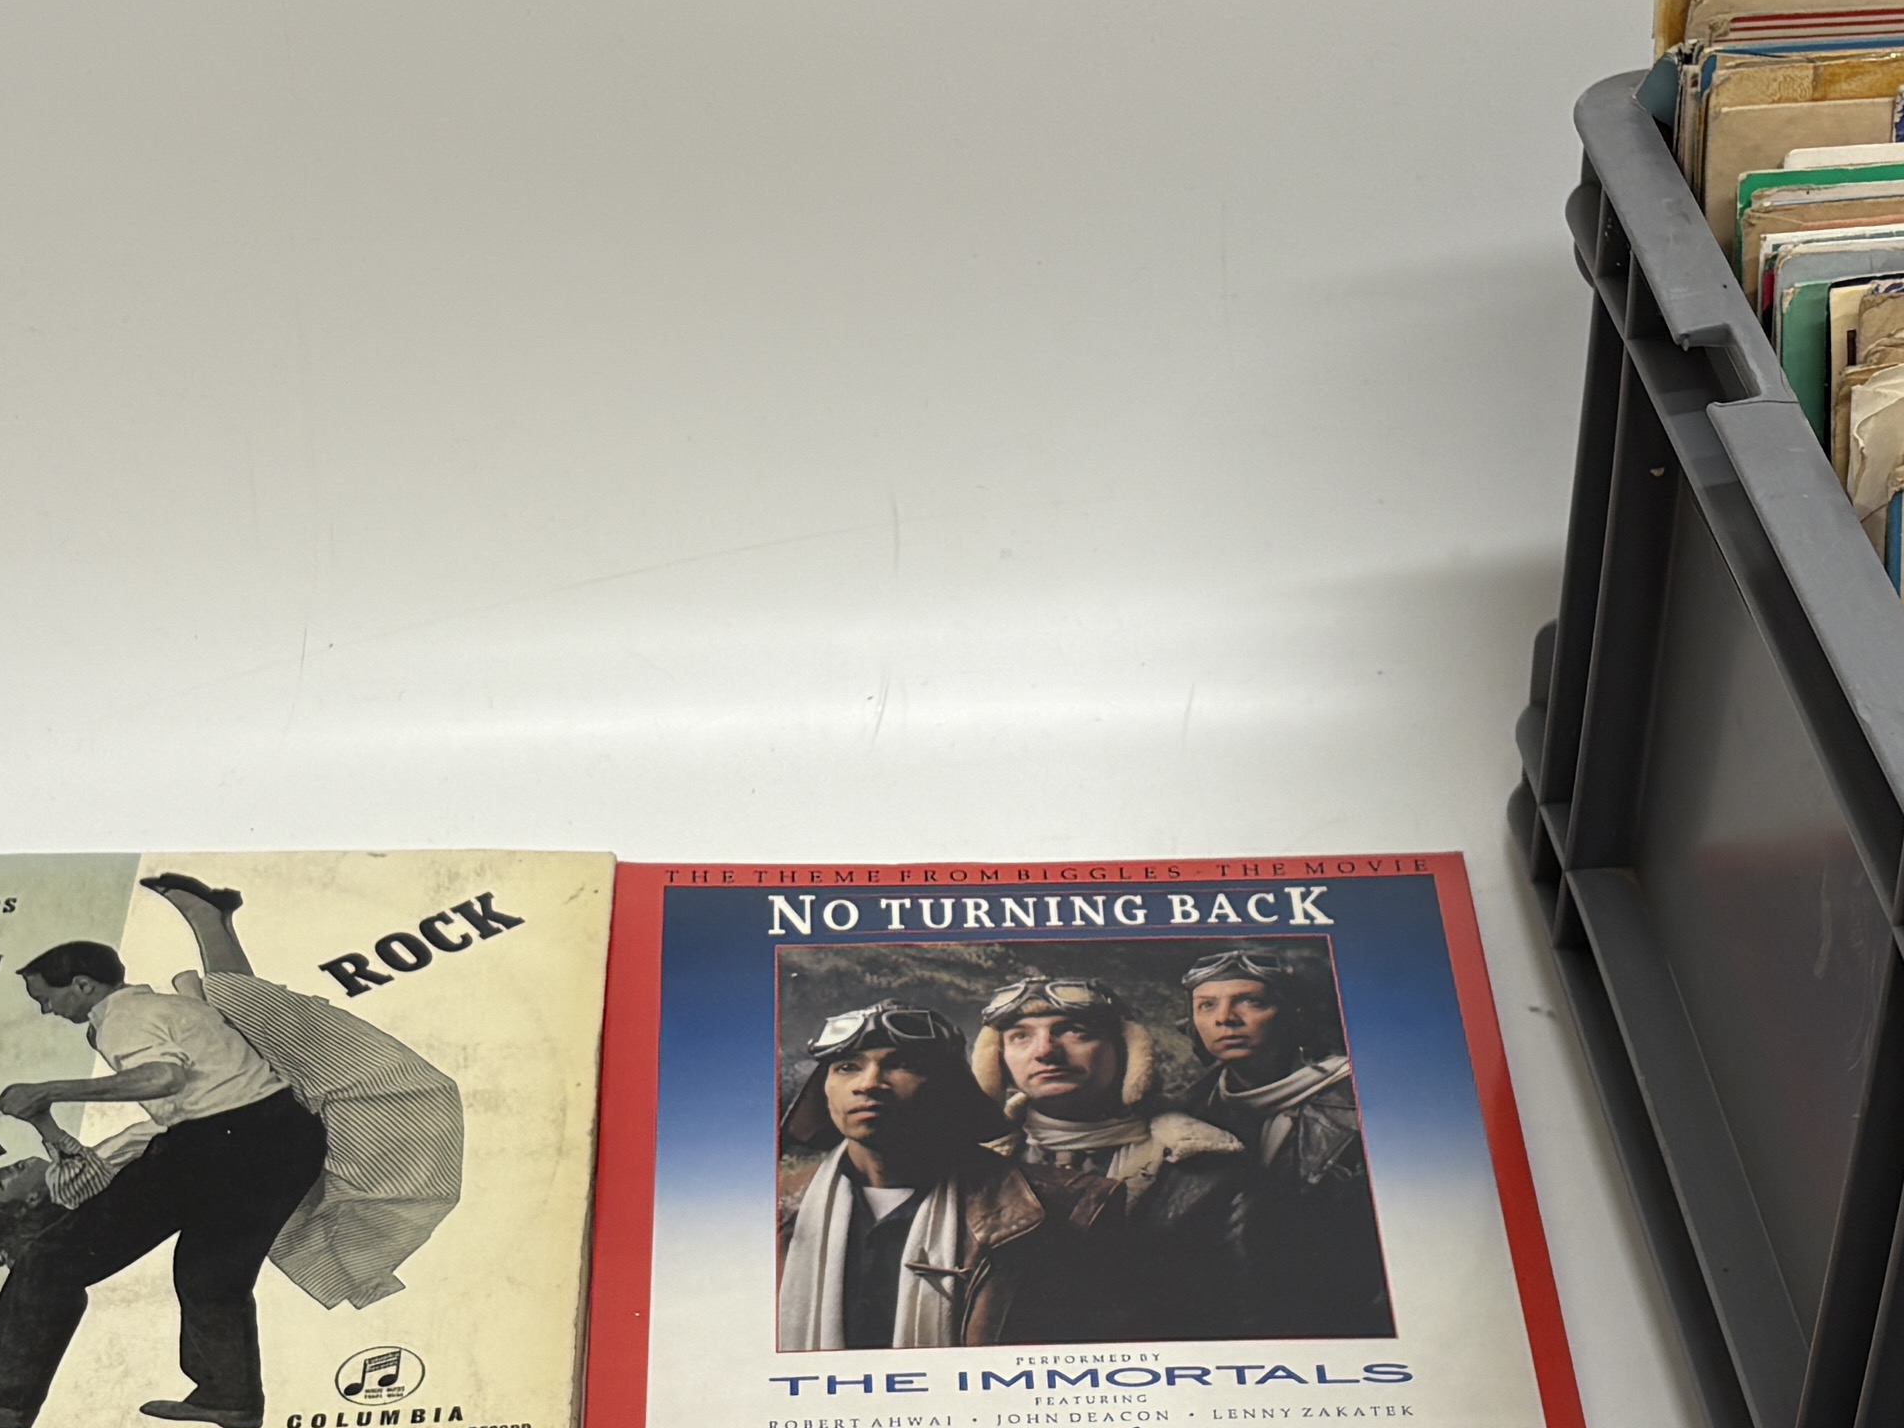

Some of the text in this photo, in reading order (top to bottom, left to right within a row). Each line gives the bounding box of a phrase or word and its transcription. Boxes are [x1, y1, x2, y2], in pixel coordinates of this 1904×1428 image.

[665, 858, 1430, 885] THE THEME FROM BIGGLES THE MOVIE
[767, 885, 1336, 937] NO TURNING BACK
[317, 891, 526, 998] ROCK
[1014, 1353, 1132, 1367] PERFORMED
[768, 1363, 1414, 1397] THE IMMORTALS
[1034, 1393, 1149, 1407] FEATURING
[871, 1414, 953, 1428] AHWAI
[996, 1412, 1059, 1427] JOHN
[1069, 1410, 1170, 1424] DEACON
[1212, 1406, 1292, 1421] LENNY
[1301, 1404, 1415, 1419] ZAKATEK
